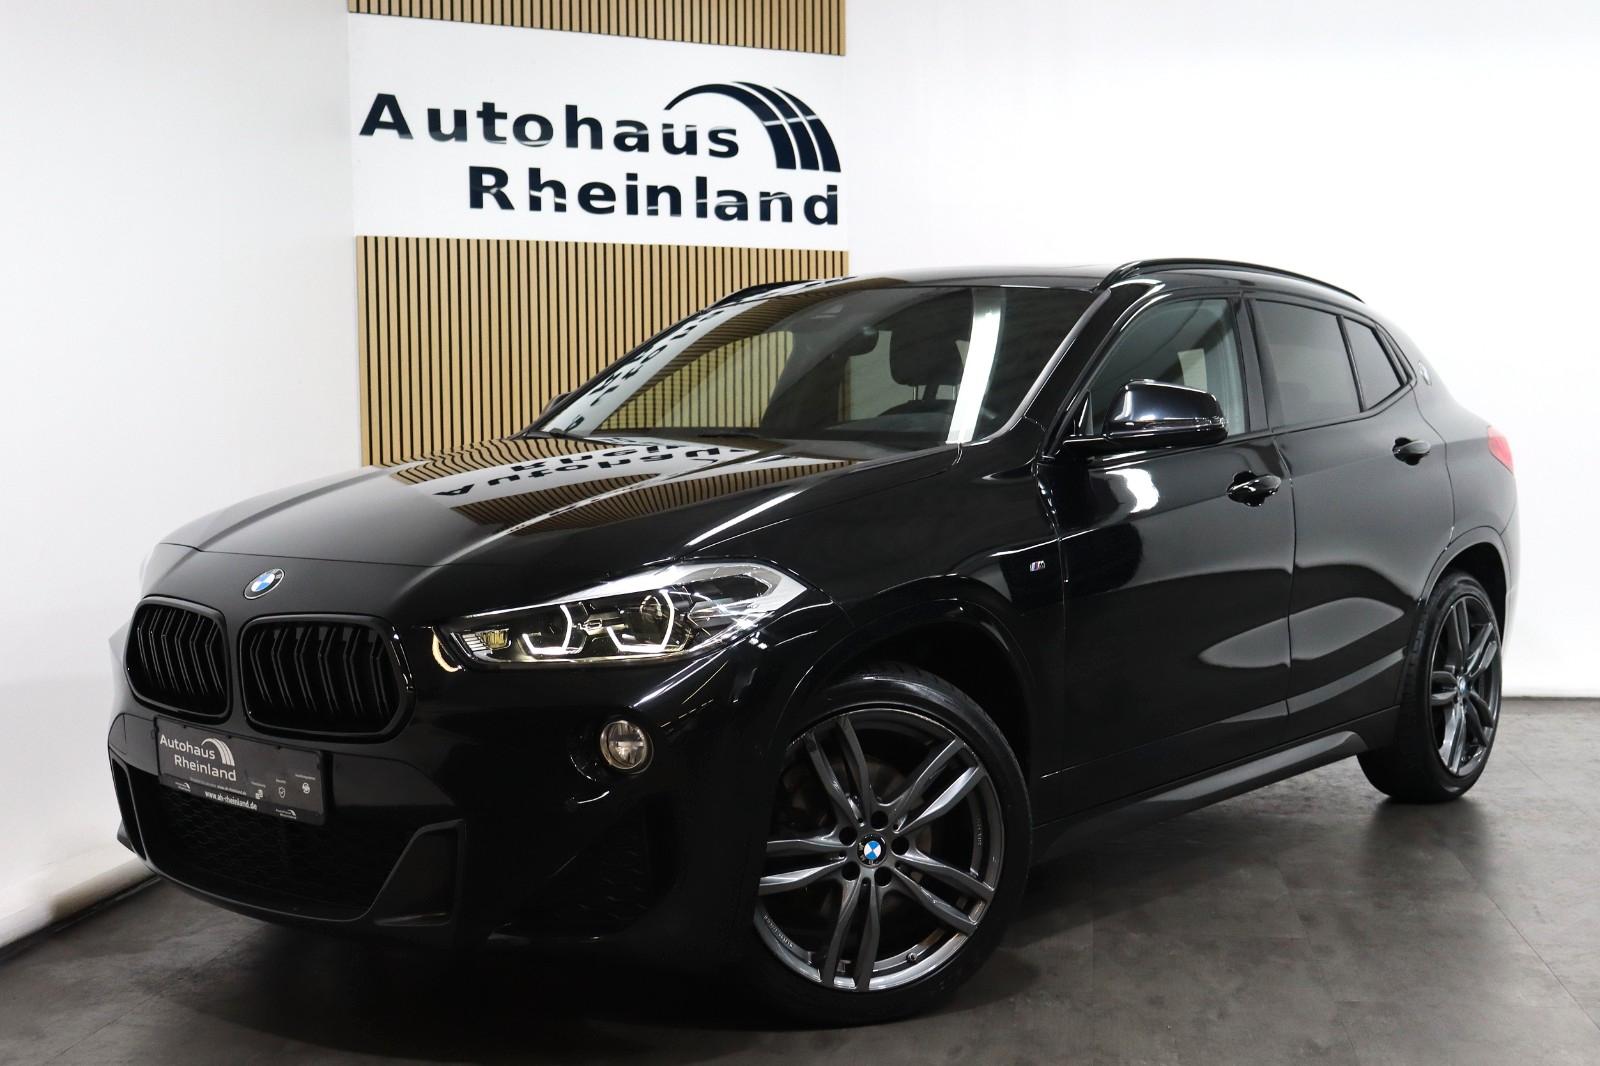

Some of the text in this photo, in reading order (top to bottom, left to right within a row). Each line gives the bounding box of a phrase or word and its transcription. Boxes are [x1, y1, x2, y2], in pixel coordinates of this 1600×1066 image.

[359, 93, 741, 160] Autohaus
[468, 165, 839, 226] Rheinland
[160, 734, 216, 760] Autohaus
[174, 754, 237, 782] Rheinland
